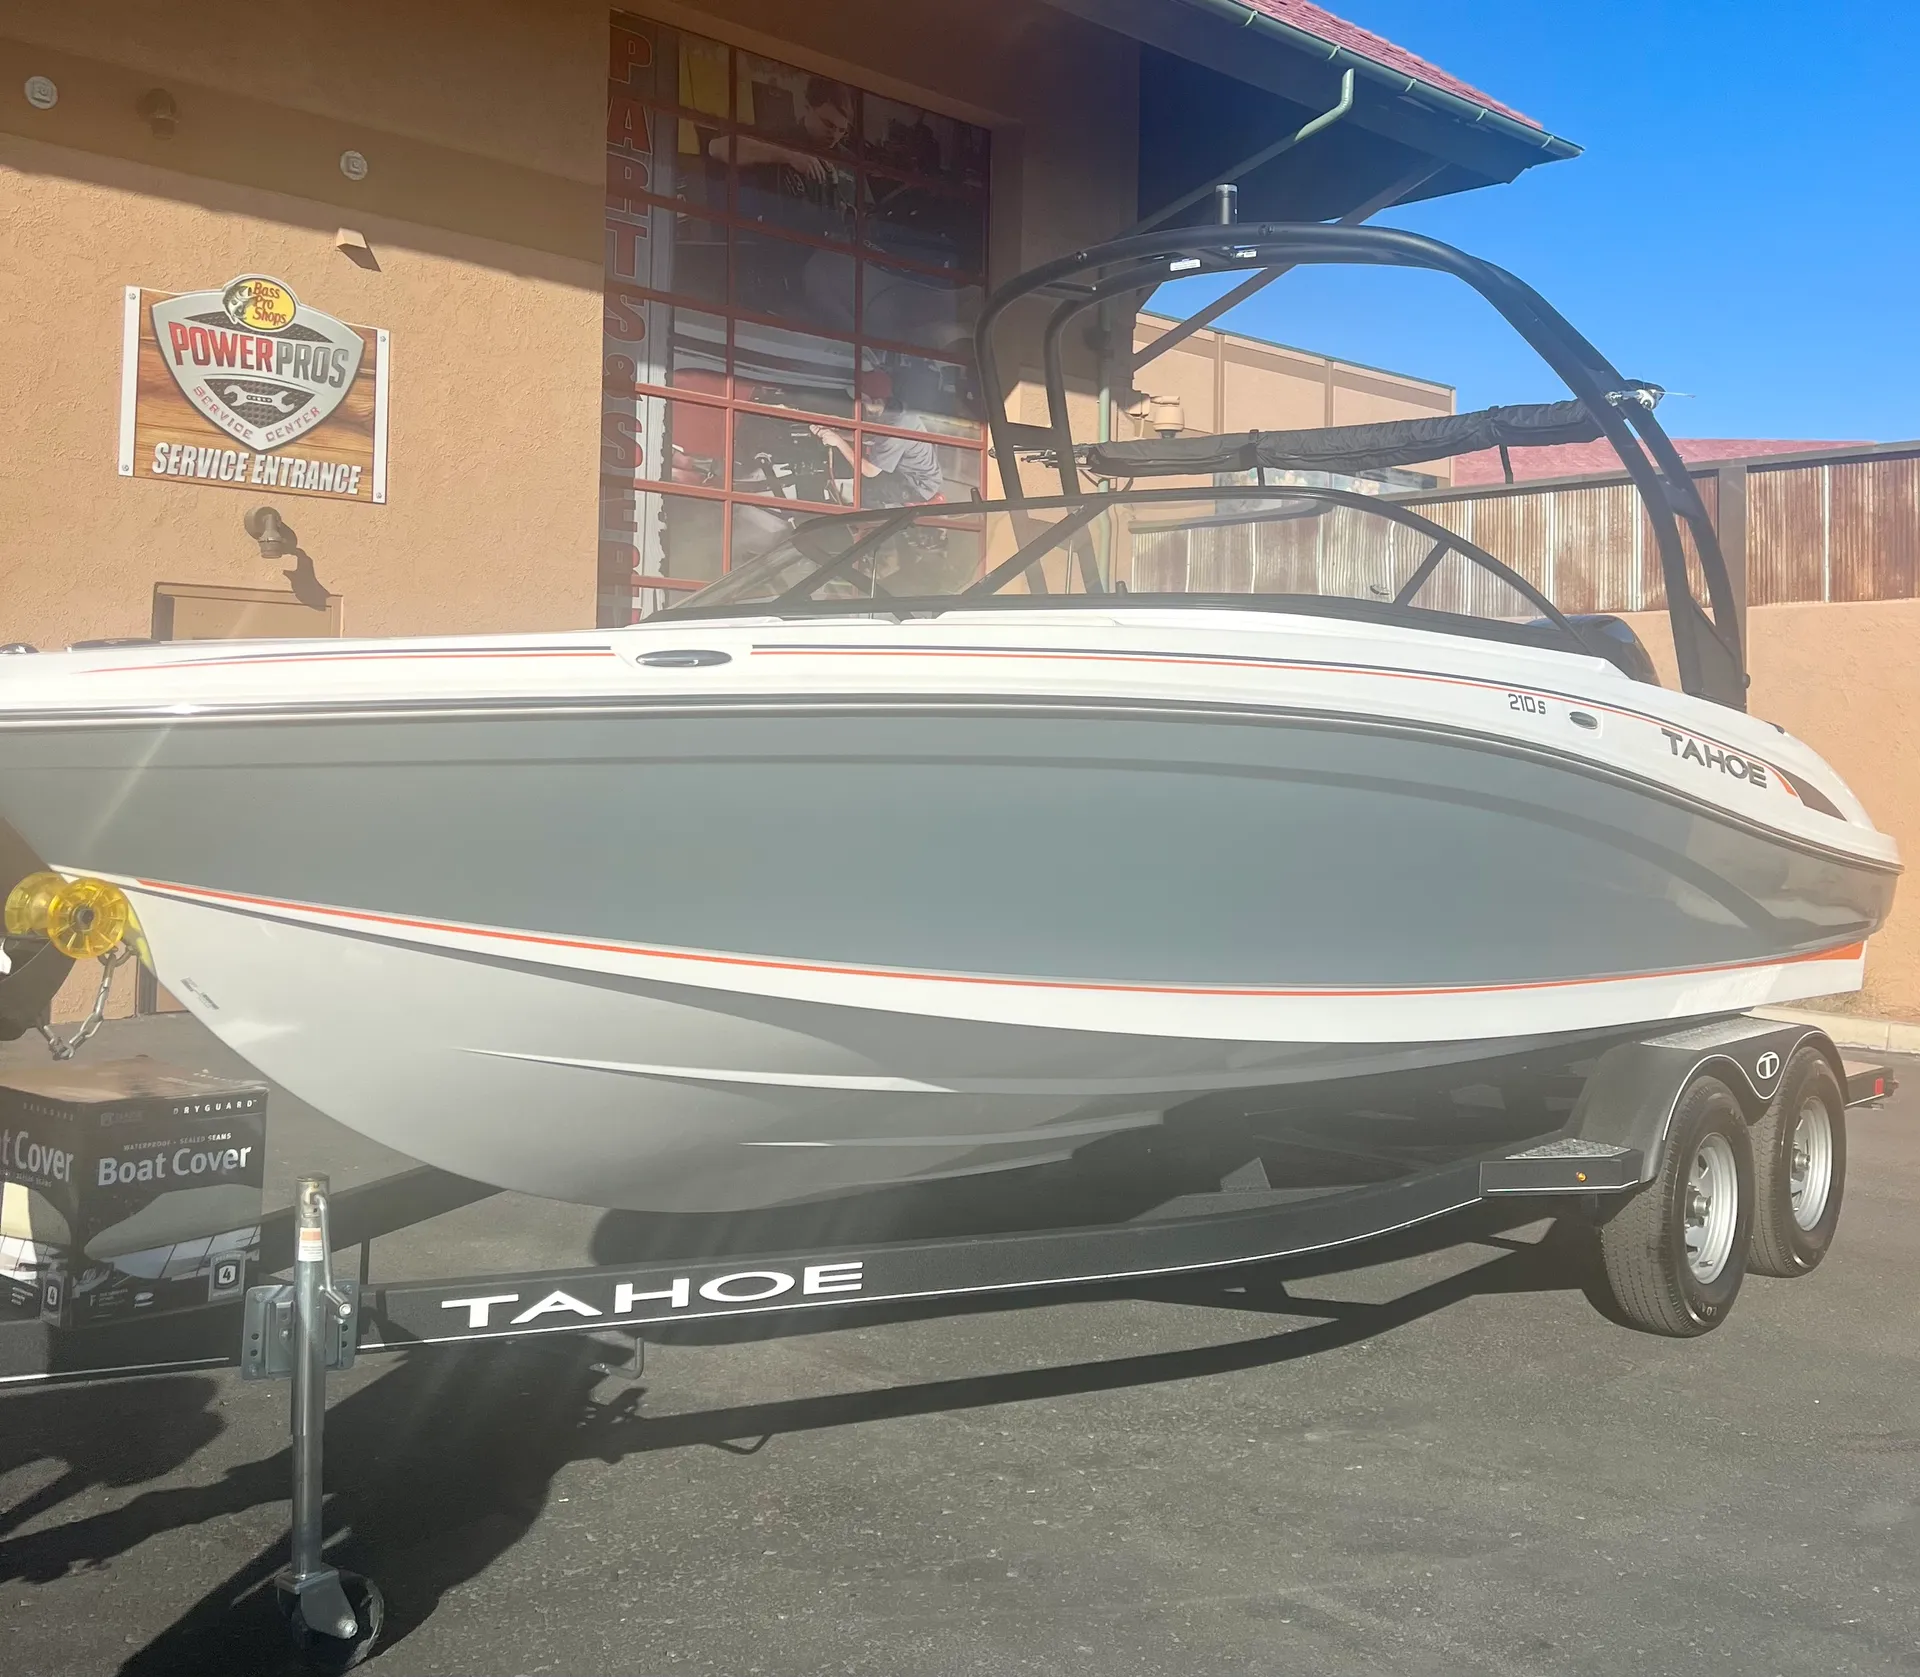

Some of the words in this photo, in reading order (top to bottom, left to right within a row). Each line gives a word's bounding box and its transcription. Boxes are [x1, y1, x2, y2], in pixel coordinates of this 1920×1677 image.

[604, 24, 653, 343] PARTS
[252, 281, 281, 300] Bass
[253, 295, 274, 312] Pro
[252, 309, 287, 327] Shops
[192, 385, 253, 440] SERVICE
[266, 406, 321, 442] CENTER
[152, 442, 249, 483] SERVICE
[251, 454, 362, 495] ENTRANCE
[1661, 728, 1767, 789] TAHOE
[14, 1130, 74, 1183] Cover
[207, 1132, 232, 1142] SEAMS
[98, 1152, 167, 1187] Boat
[172, 1146, 252, 1176] Cover
[441, 1261, 864, 1328] TAHOE
